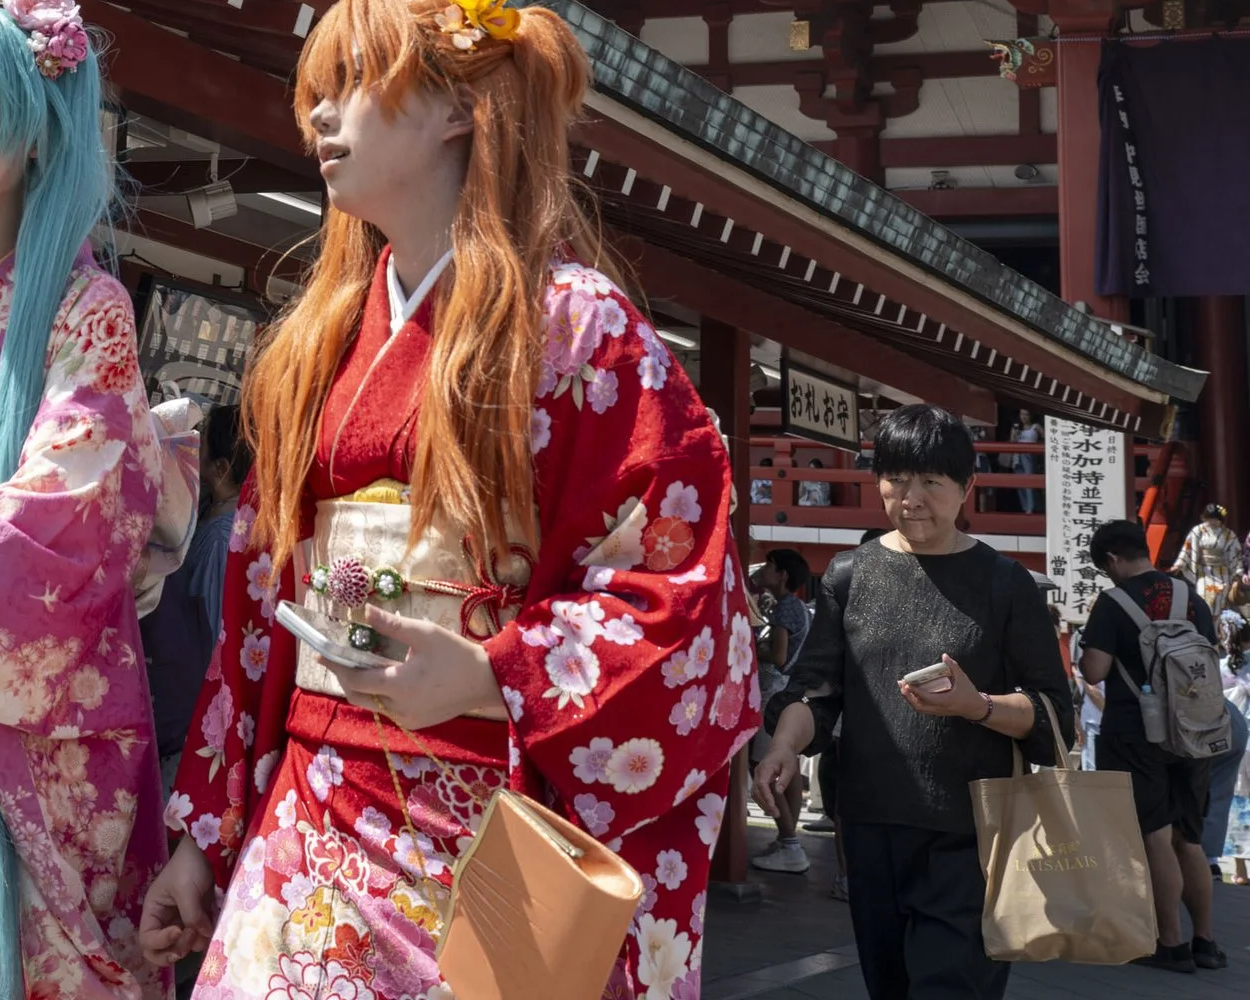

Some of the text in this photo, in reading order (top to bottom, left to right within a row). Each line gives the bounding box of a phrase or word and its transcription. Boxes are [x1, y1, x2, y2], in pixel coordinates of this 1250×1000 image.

[790, 377, 849, 435] お札お守
[1015, 855, 1098, 873] LAISALAIS
